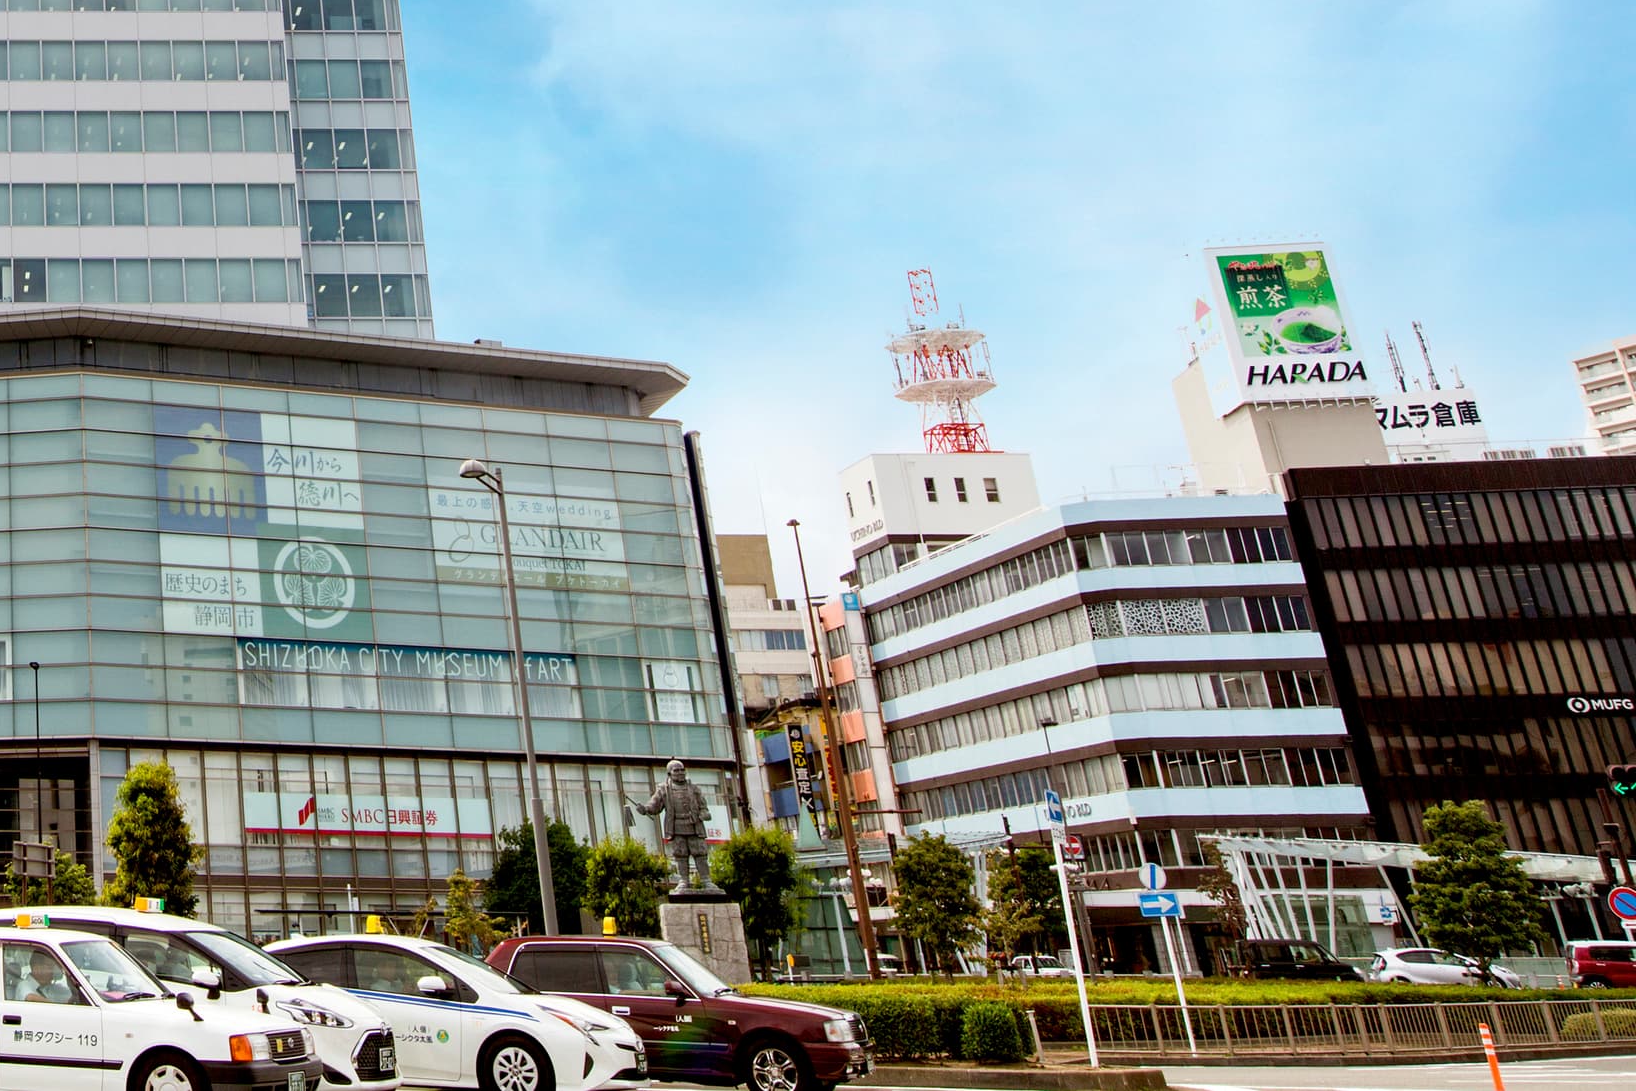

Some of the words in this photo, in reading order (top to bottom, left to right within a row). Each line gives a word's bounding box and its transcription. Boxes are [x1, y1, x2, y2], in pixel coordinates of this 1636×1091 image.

[1236, 284, 1287, 310] 煎茶
[1247, 361, 1367, 385] HARADA
[267, 448, 342, 476] 今川から
[298, 481, 360, 507] 徳川へ
[480, 524, 605, 552] GANDAIR
[453, 568, 548, 583] グランデエール
[510, 559, 549, 570] ouquet
[164, 573, 247, 597] 歴史のまち
[194, 605, 254, 628] 静岡市
[244, 642, 352, 671] SHIZUOKA
[360, 648, 403, 673] CITY
[416, 651, 504, 678] MUSEUM
[514, 657, 532, 679] f
[538, 658, 573, 681] ART
[1590, 699, 1635, 710] MUFG
[341, 808, 438, 825] SMBC日興証券
[14, 1030, 73, 1043] 静岡タクシー
[78, 1034, 98, 1046] 119
